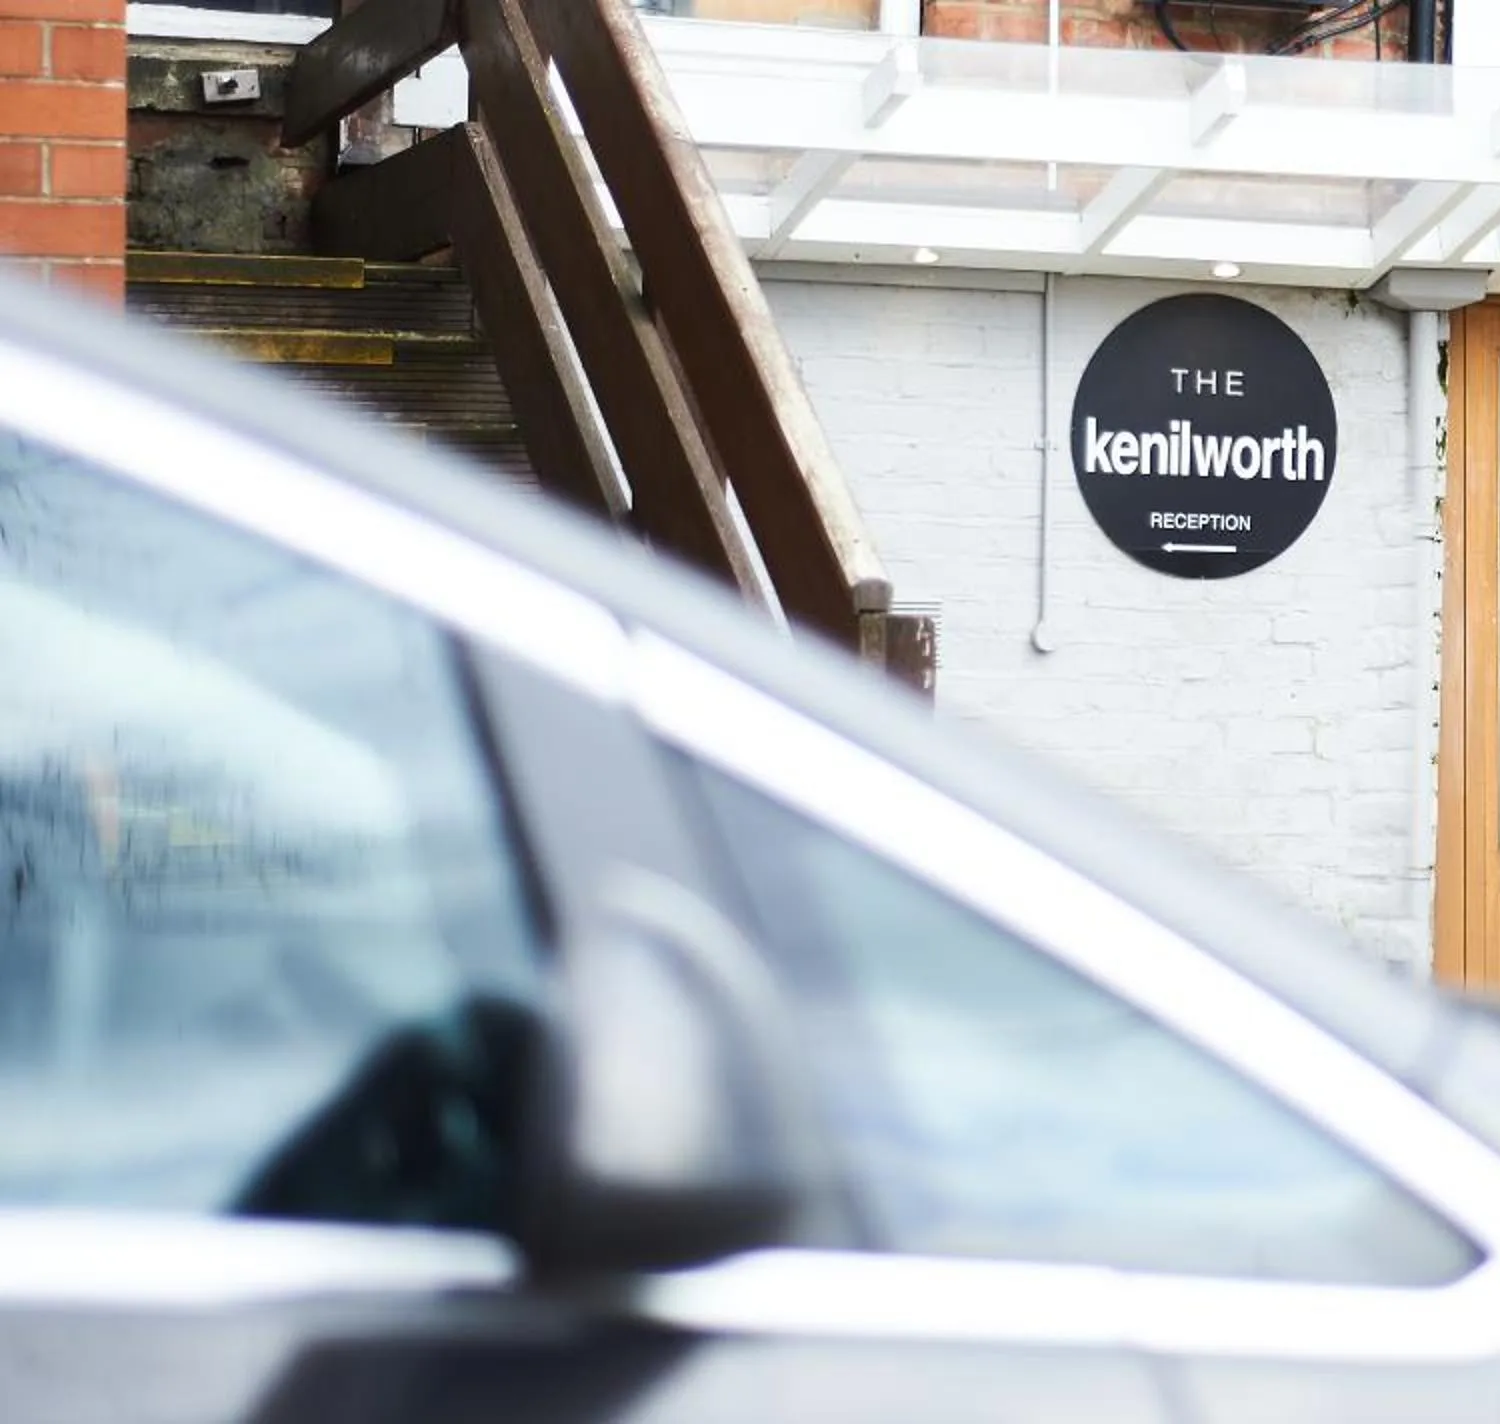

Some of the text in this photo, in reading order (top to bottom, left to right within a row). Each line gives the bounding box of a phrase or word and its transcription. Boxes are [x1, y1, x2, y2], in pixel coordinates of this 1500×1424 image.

[1170, 367, 1245, 397] THE
[1085, 416, 1326, 481] kenilworth
[1150, 511, 1251, 531] RECEPTION
